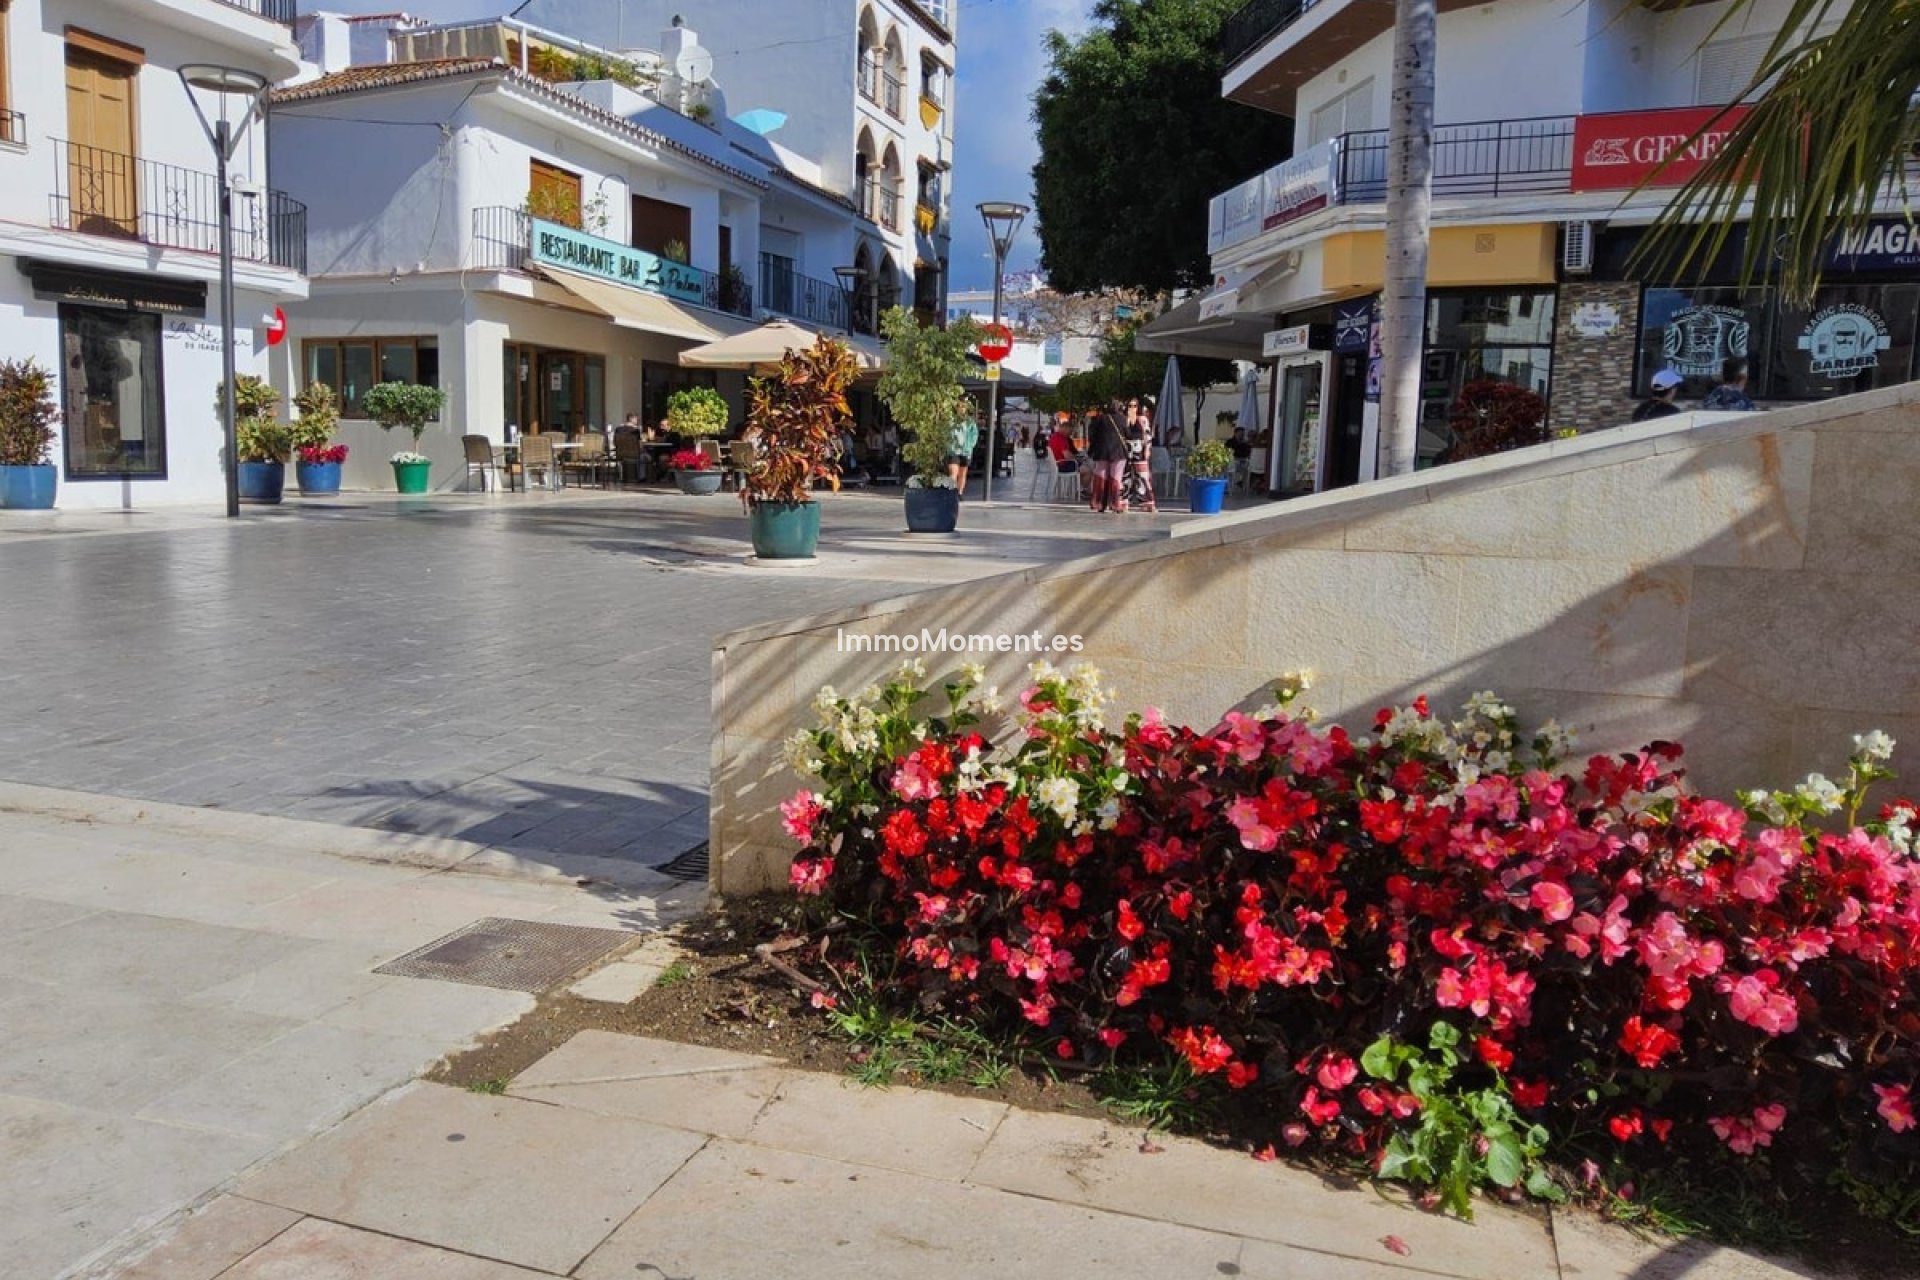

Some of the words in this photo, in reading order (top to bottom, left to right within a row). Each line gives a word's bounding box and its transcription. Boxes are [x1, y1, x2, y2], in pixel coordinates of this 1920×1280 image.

[1840, 223, 1920, 255] MAGI
[540, 231, 615, 274] RESTAURANTE
[619, 255, 641, 281] BAR
[1803, 304, 1836, 335] MAGIC
[1839, 302, 1889, 336] SCISSORS
[1811, 356, 1878, 372] BARBER
[1829, 367, 1861, 378] SHOP
